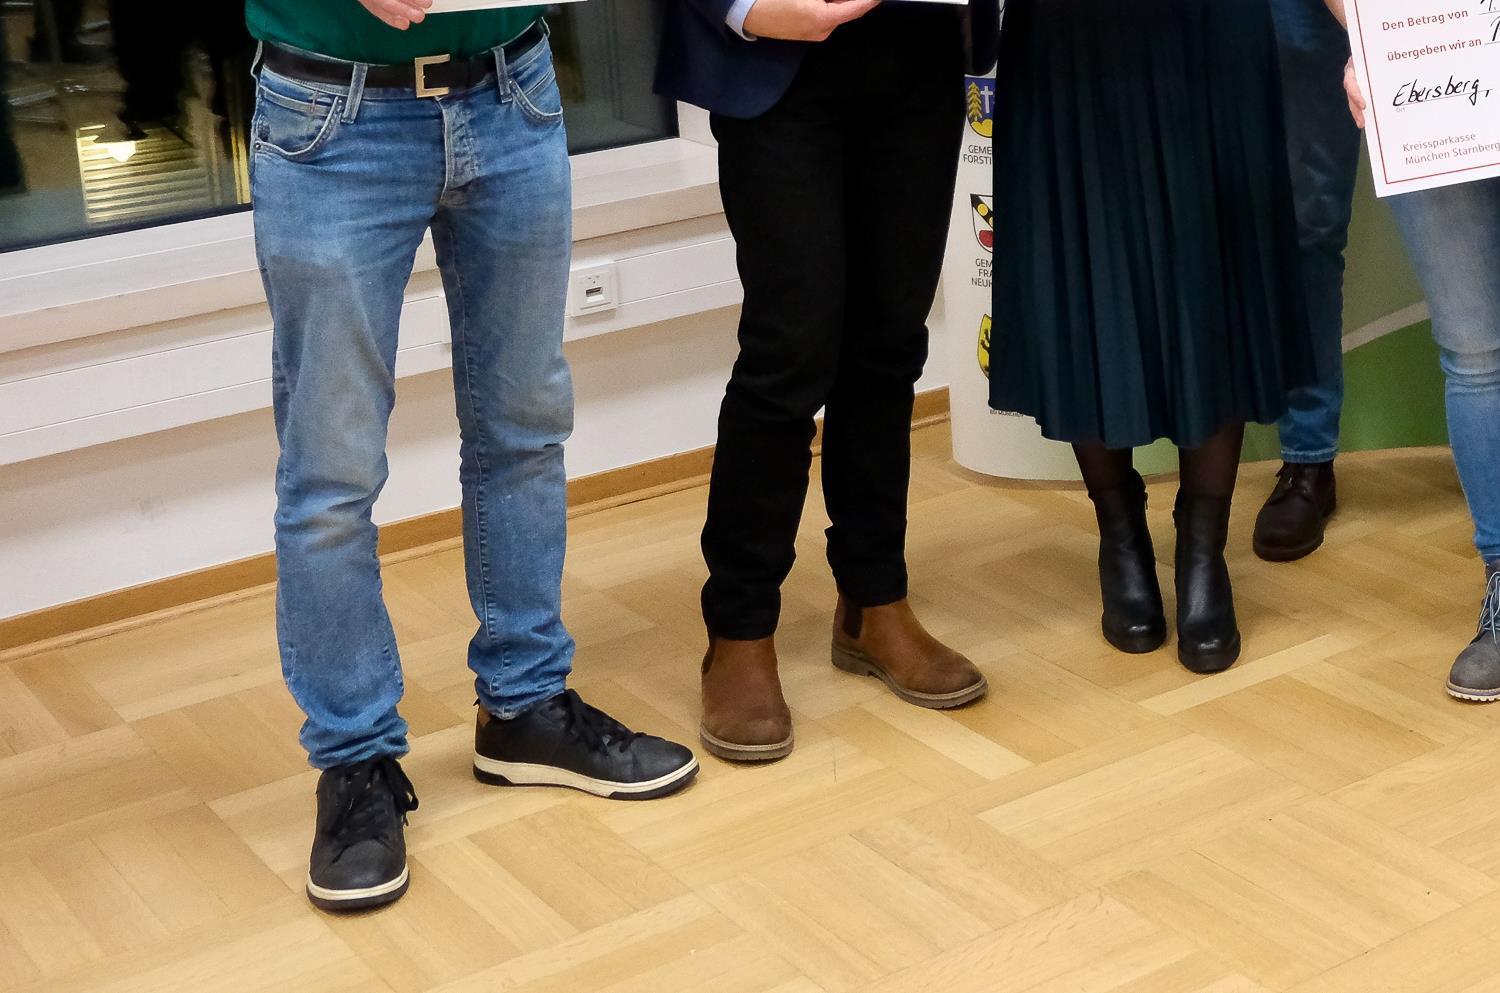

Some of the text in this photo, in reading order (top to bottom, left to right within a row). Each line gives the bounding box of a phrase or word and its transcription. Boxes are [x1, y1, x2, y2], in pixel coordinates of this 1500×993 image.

[1382, 19, 1404, 31] Den
[1407, 14, 1445, 27] Betrag
[1448, 9, 1469, 19] von
[1387, 43, 1447, 61] übergeben
[1448, 39, 1466, 50] wir
[1468, 37, 1482, 47] an
[1402, 131, 1477, 152] Kreissparkasse
[1404, 149, 1451, 166] München
[1452, 141, 1500, 159] Starnberg
